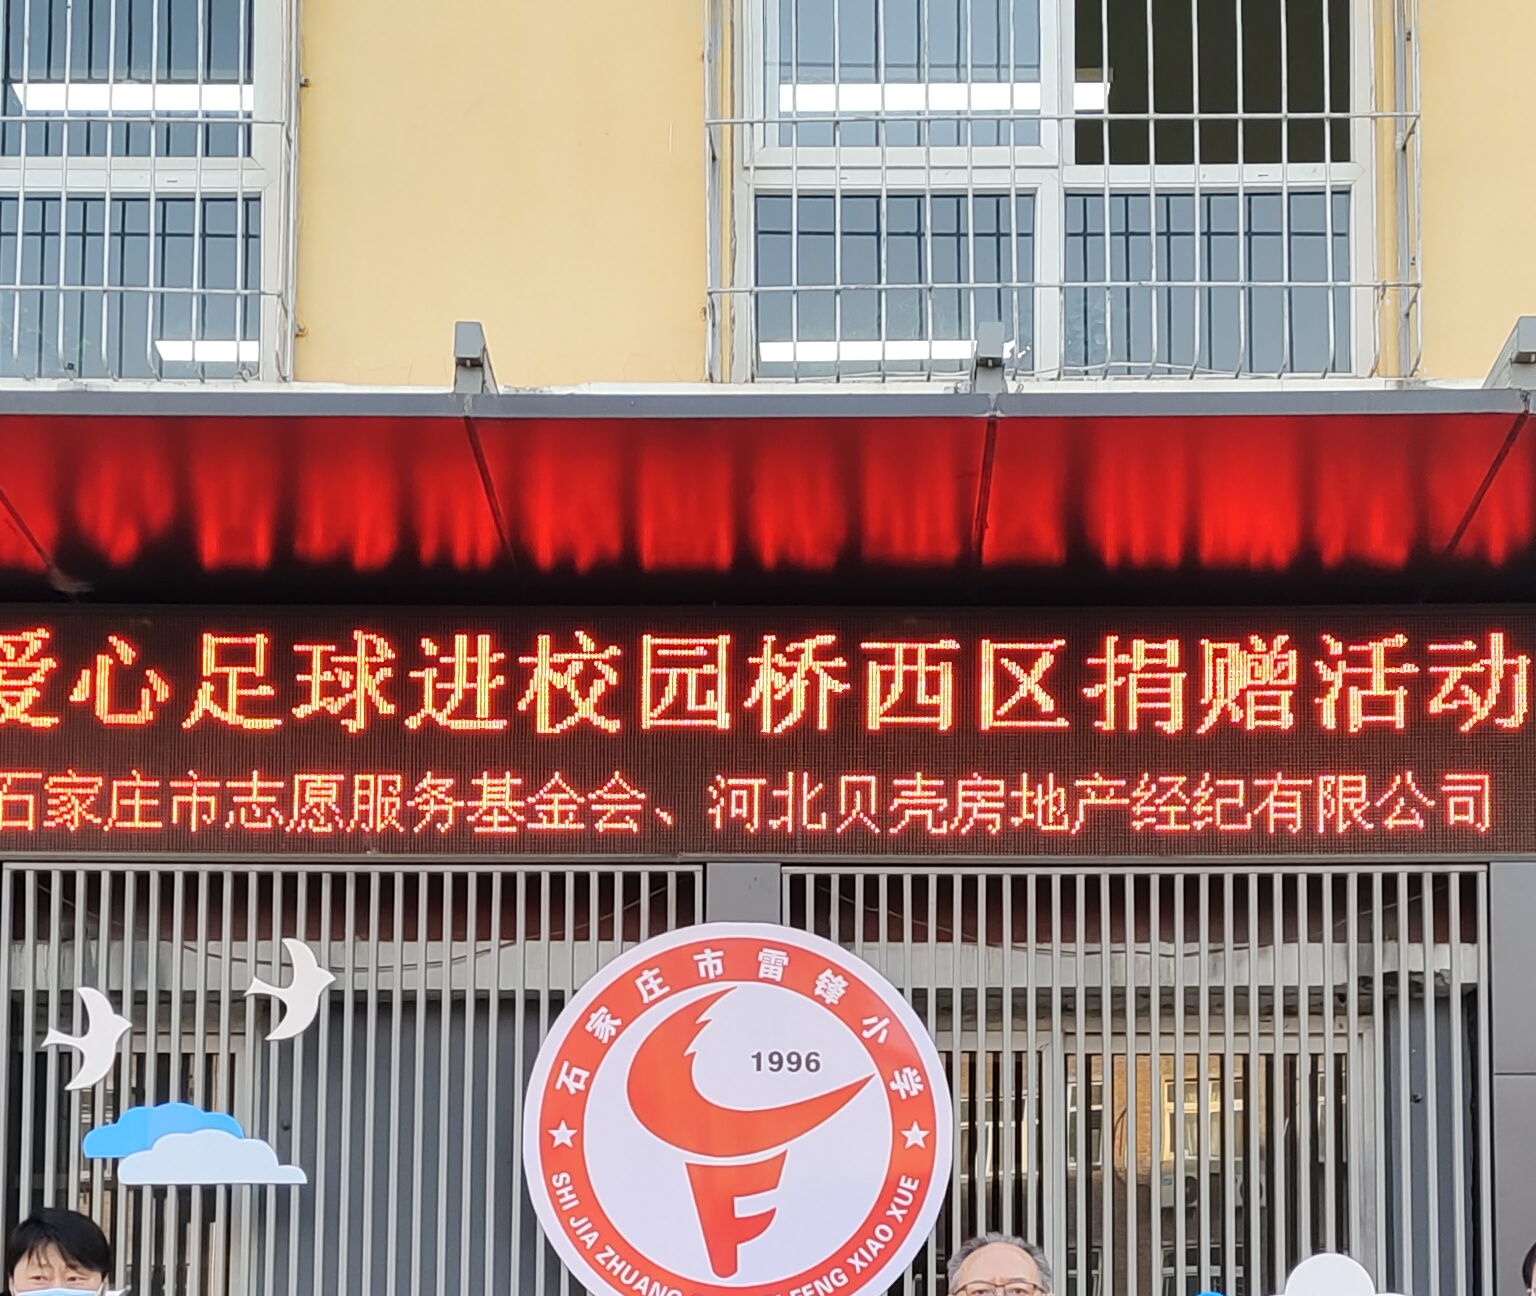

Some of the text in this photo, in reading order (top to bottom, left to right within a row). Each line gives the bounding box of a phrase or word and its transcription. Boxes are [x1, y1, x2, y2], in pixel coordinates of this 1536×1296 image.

[555, 947, 924, 1100] 石家庄市雷锋小学
[751, 1051, 821, 1073] 1996
[551, 1172, 580, 1211] SHI
[569, 1216, 600, 1250] JIA
[846, 1223, 894, 1275] XIAO
[885, 1175, 921, 1223] XUE
